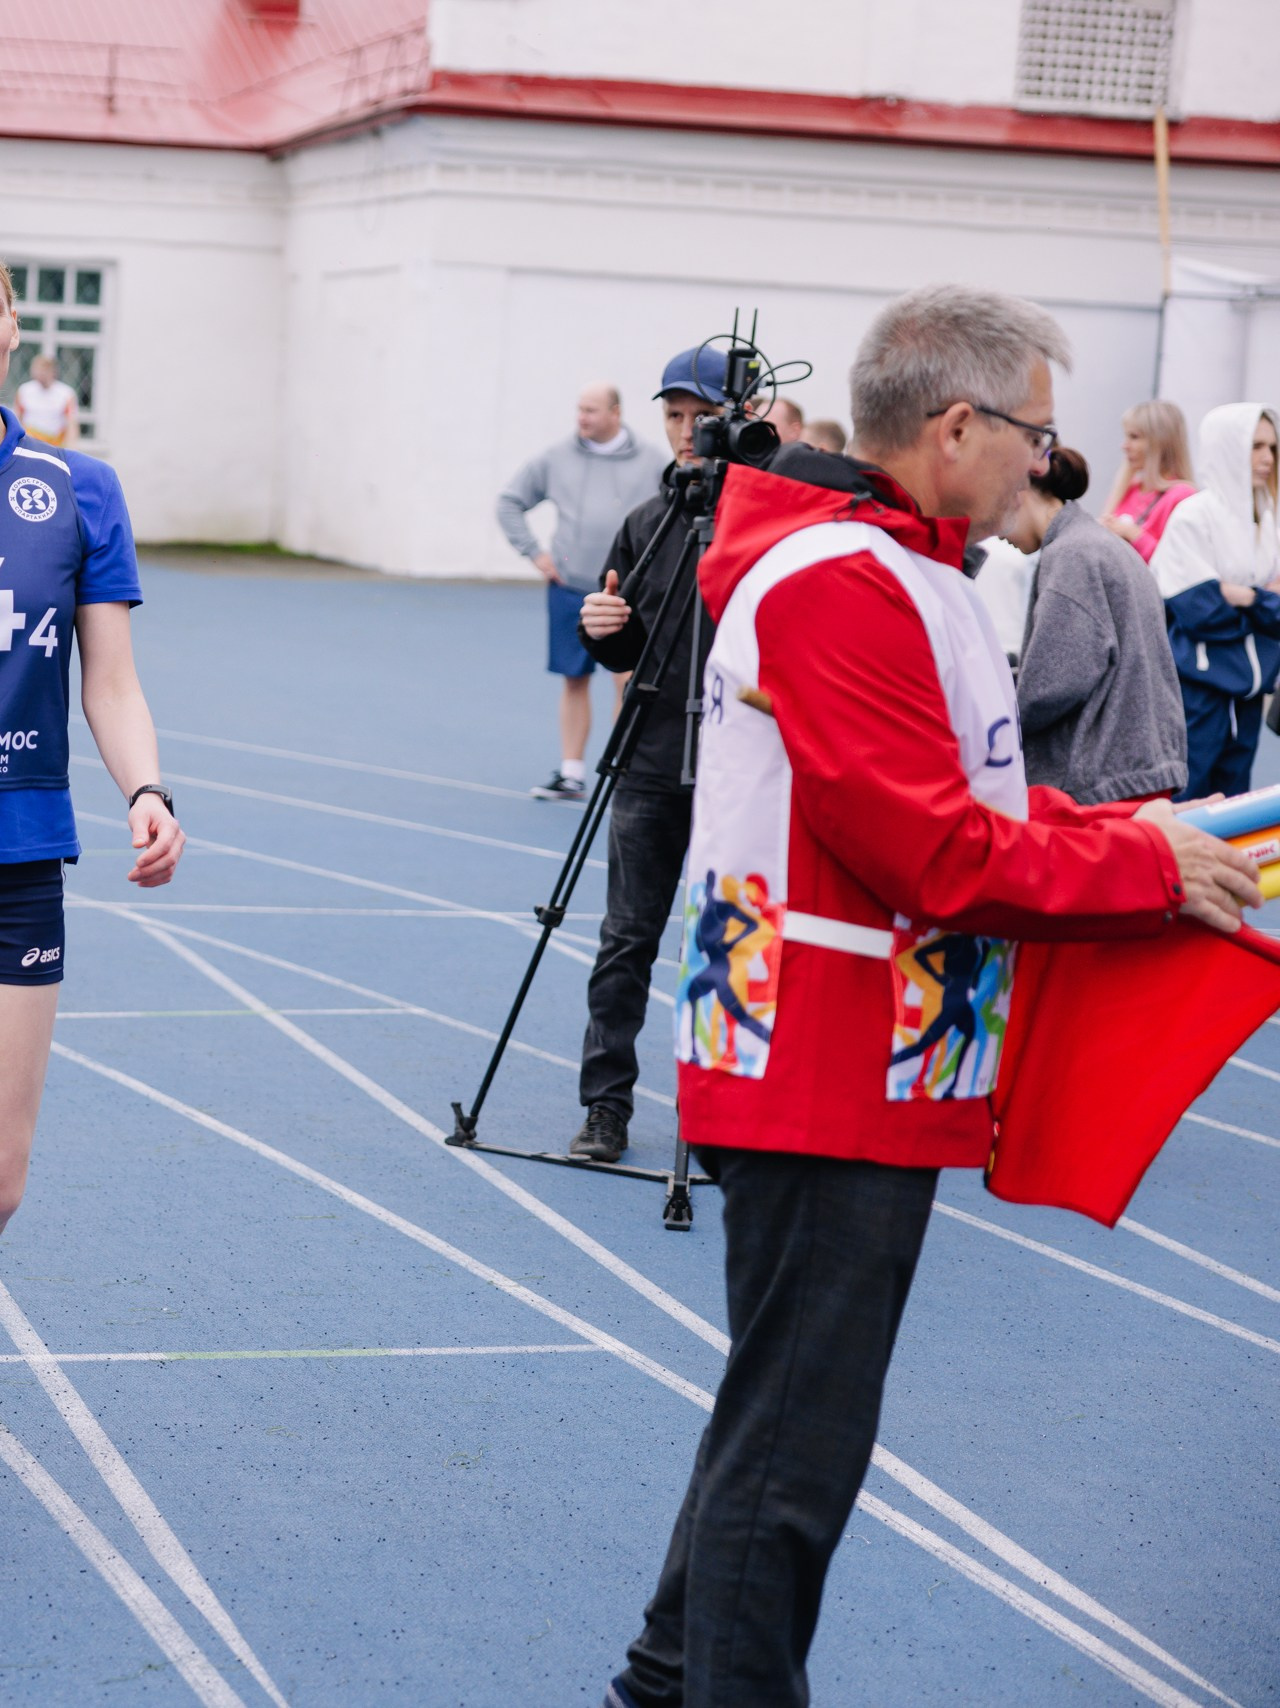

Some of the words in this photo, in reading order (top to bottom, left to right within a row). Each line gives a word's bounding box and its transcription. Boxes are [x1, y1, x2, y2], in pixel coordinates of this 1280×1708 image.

[12, 479, 31, 491] КОМОС
[33, 480, 51, 493] ГРУПП
[15, 506, 54, 520] СПАРТАКИАДА
[40, 946, 60, 963] asics
